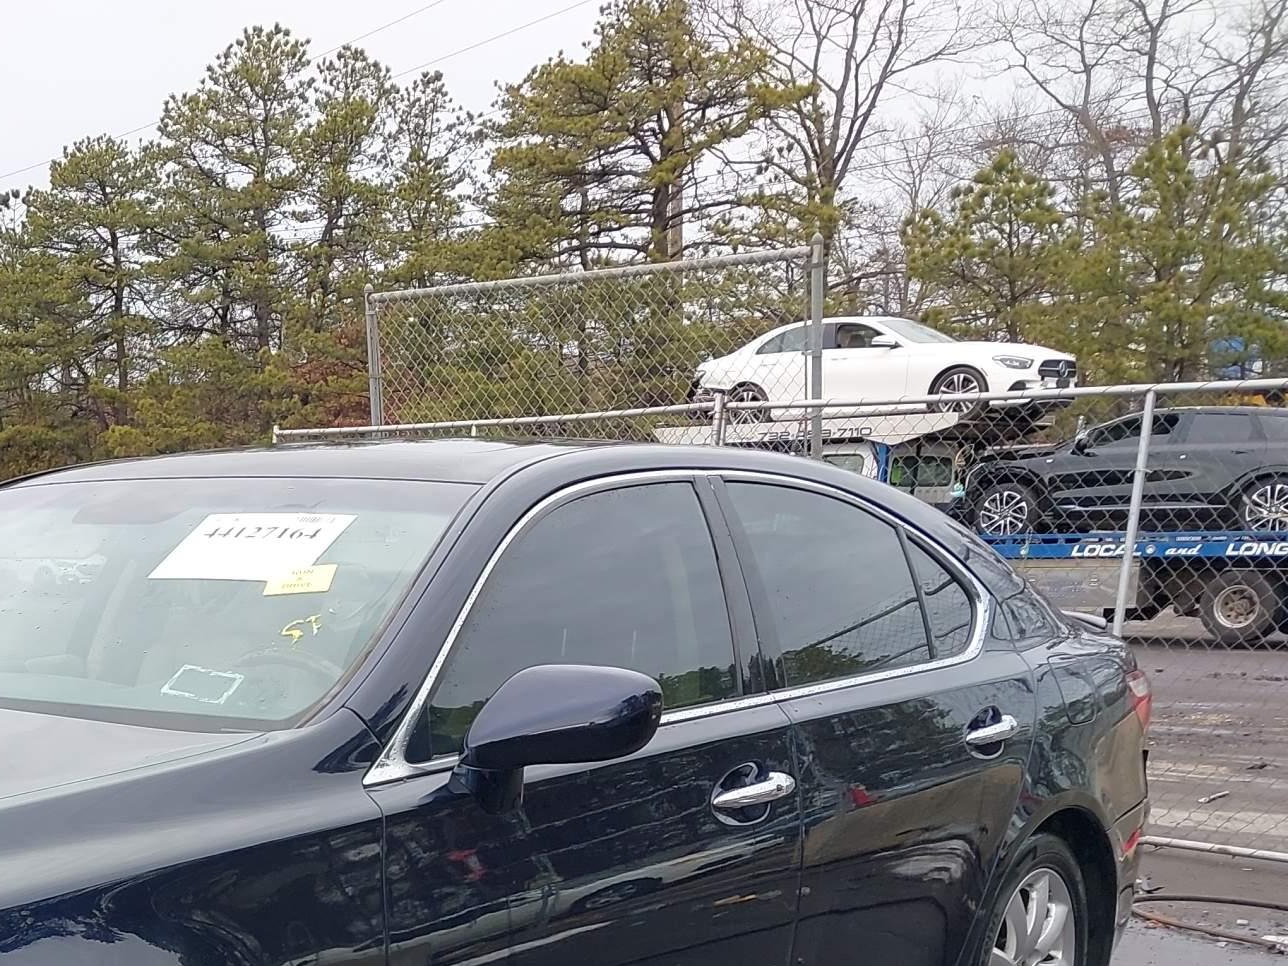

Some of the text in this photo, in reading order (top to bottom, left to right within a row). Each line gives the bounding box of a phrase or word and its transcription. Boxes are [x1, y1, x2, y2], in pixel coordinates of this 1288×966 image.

[204, 526, 323, 540] 44127164
[1070, 543, 1142, 557] LOCAL
[1164, 543, 1203, 556] and
